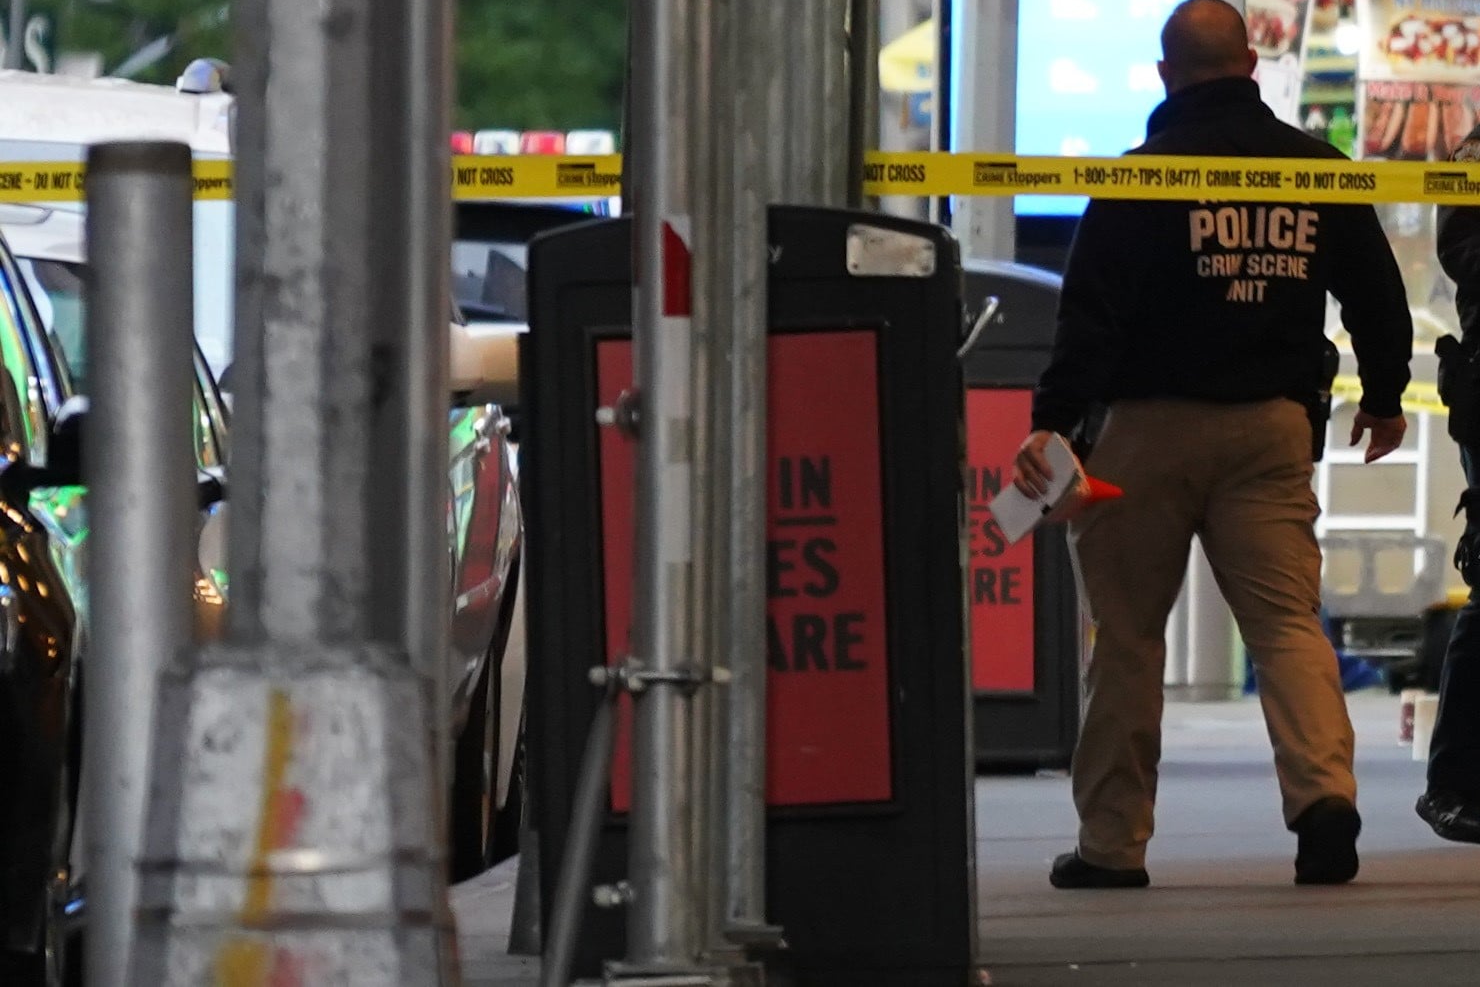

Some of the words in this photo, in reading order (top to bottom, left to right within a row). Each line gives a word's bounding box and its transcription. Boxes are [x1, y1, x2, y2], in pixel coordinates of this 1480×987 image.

[457, 167, 477, 185] NOT
[480, 167, 514, 186] CROSS
[888, 163, 926, 183] CROSS
[1073, 166, 1162, 186] 1-800-577-TIPS
[1165, 167, 1200, 188] (8477)
[1206, 169, 1241, 188] CRIME
[1245, 171, 1282, 189] SCENE
[1295, 172, 1310, 190] DO
[1313, 172, 1336, 191] NOT
[1339, 172, 1376, 192] CROSS
[1188, 206, 1320, 254] POLICE
[1246, 253, 1309, 280] SCENE
[1226, 278, 1268, 303] NIT
